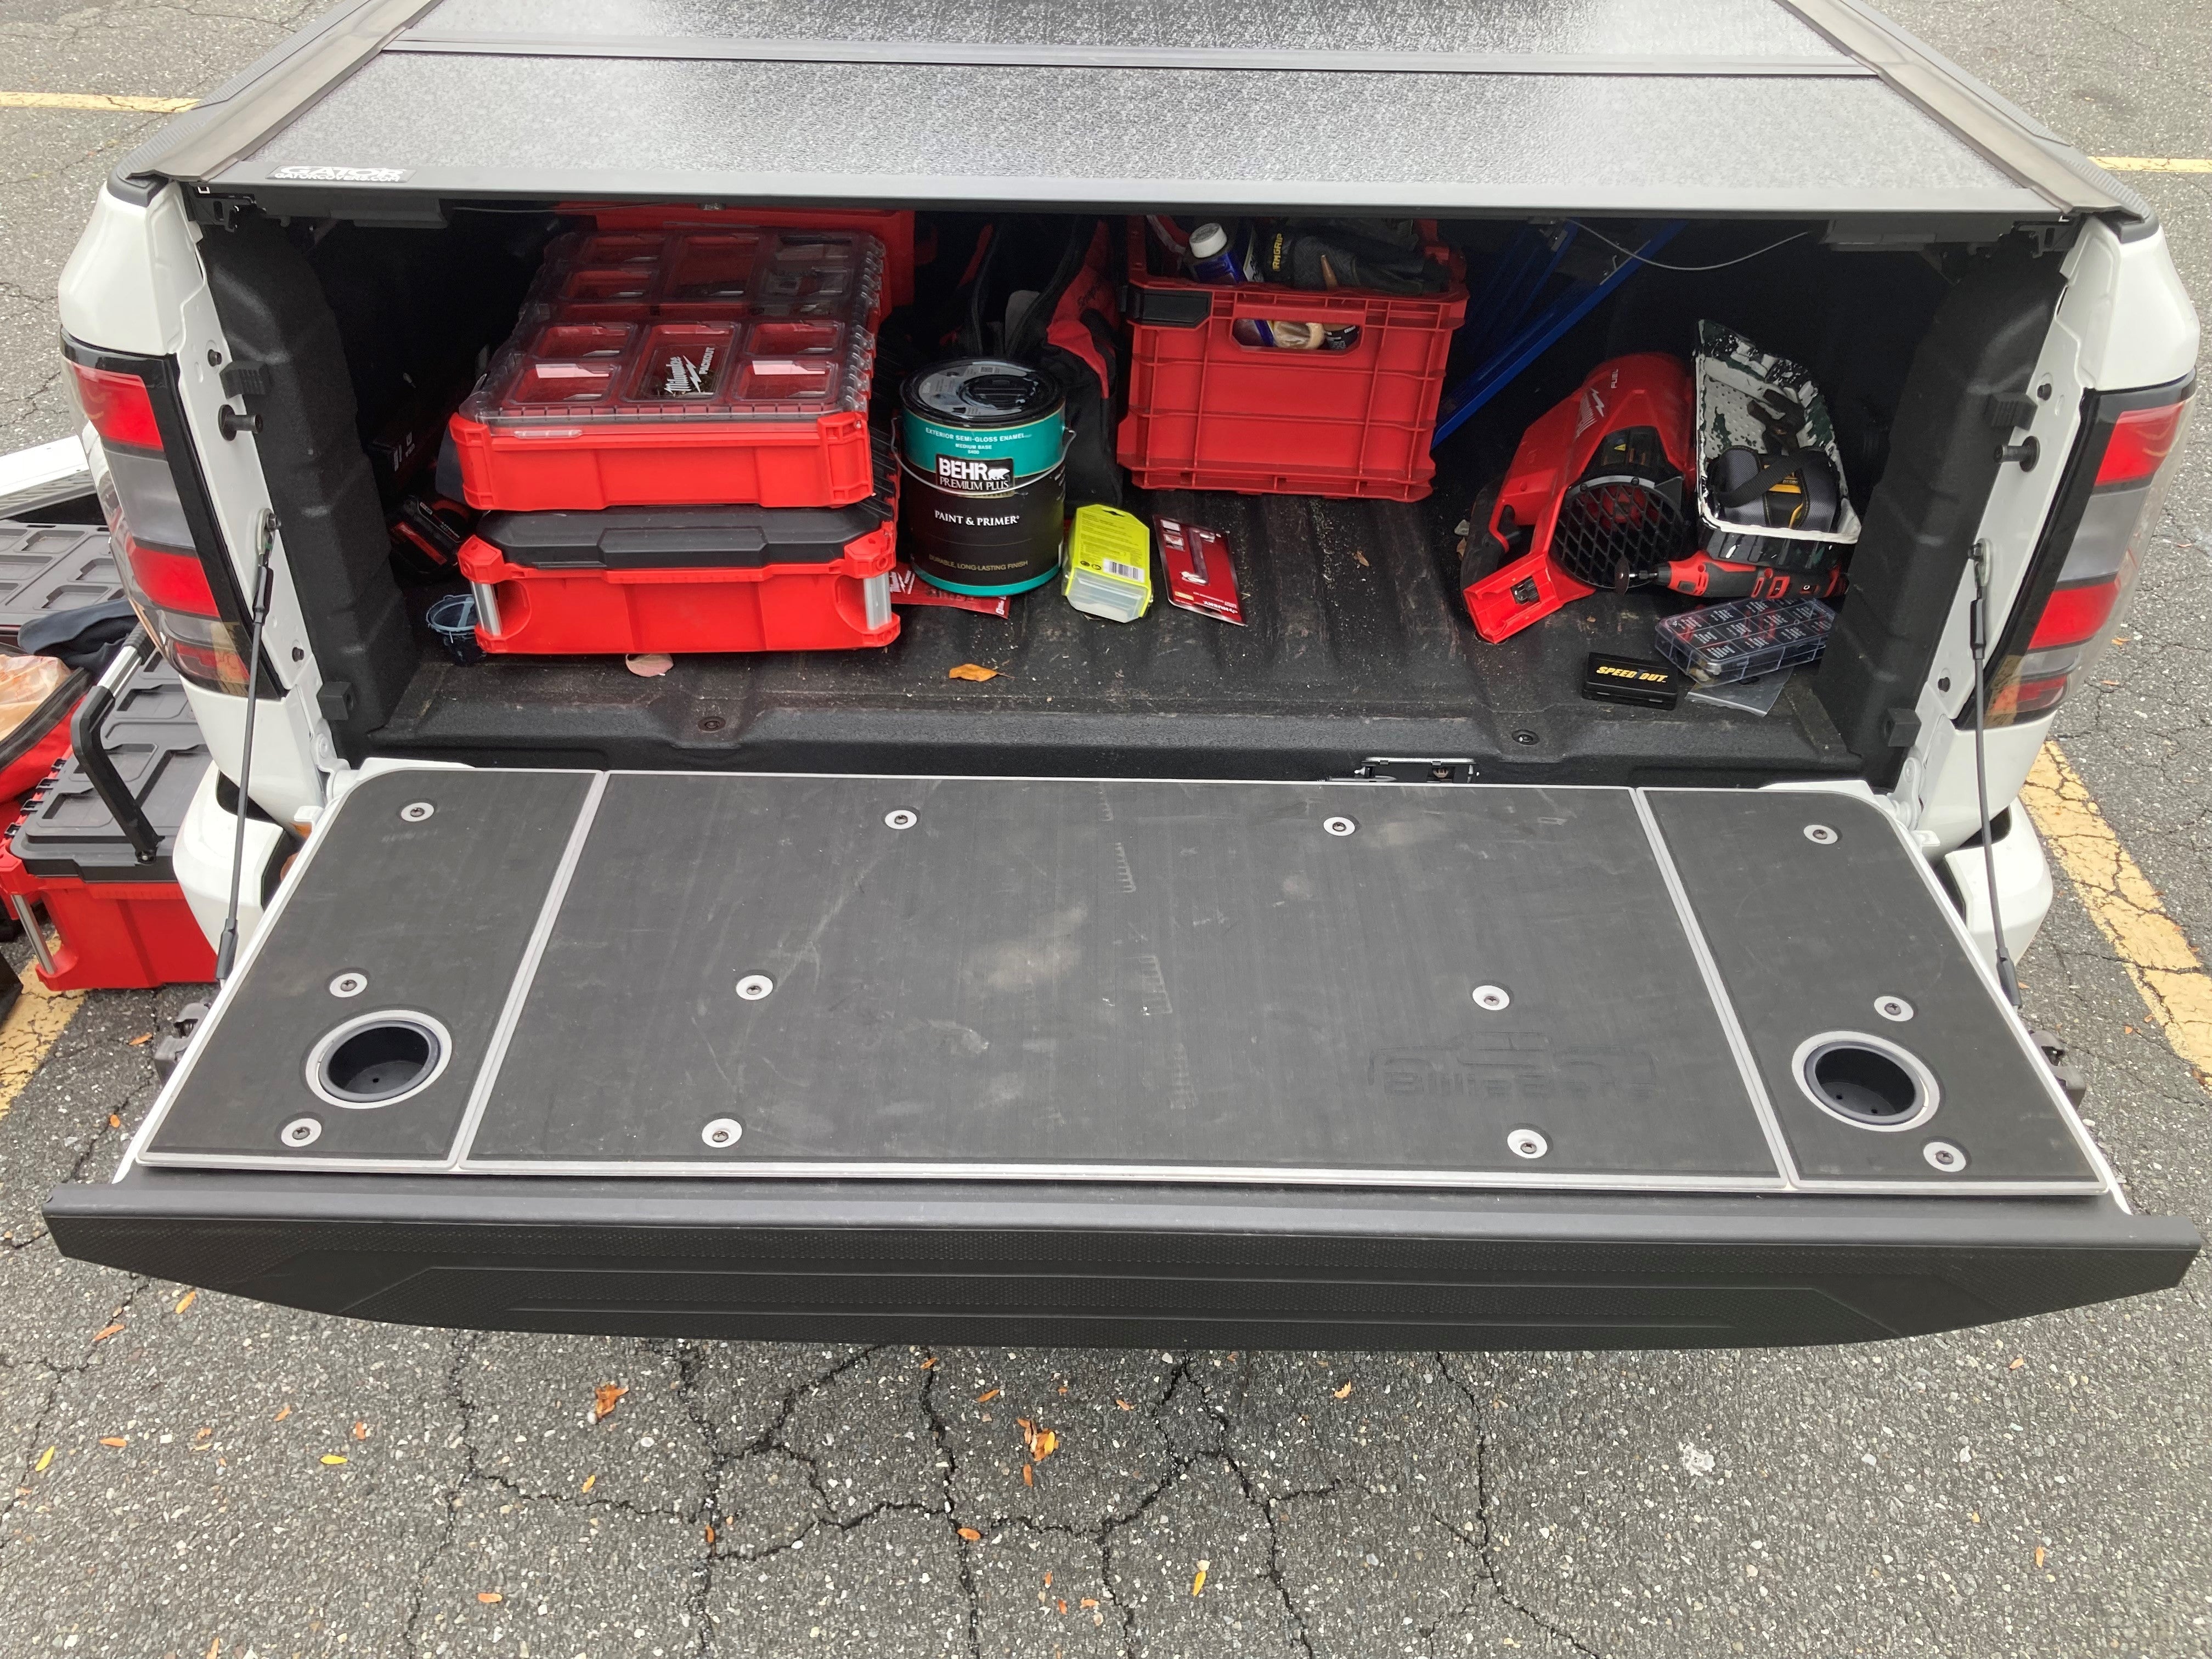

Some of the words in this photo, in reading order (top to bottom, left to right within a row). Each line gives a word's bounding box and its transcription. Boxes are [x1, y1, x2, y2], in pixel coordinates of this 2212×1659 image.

[280, 166, 405, 177] GATOR
[699, 347, 715, 374] PACKOUT
[926, 427, 954, 439] EXTERIOR
[1000, 433, 1025, 442] ENAMEL
[938, 457, 989, 481] BEHR
[939, 477, 983, 491] PREMIUM
[986, 480, 1009, 490] PLUS
[934, 510, 963, 524] PAINT
[966, 517, 975, 526] &
[957, 563, 1007, 571] LONG-LASTING
[1007, 560, 1029, 569] FINISH
[1596, 666, 1638, 679] SPEED
